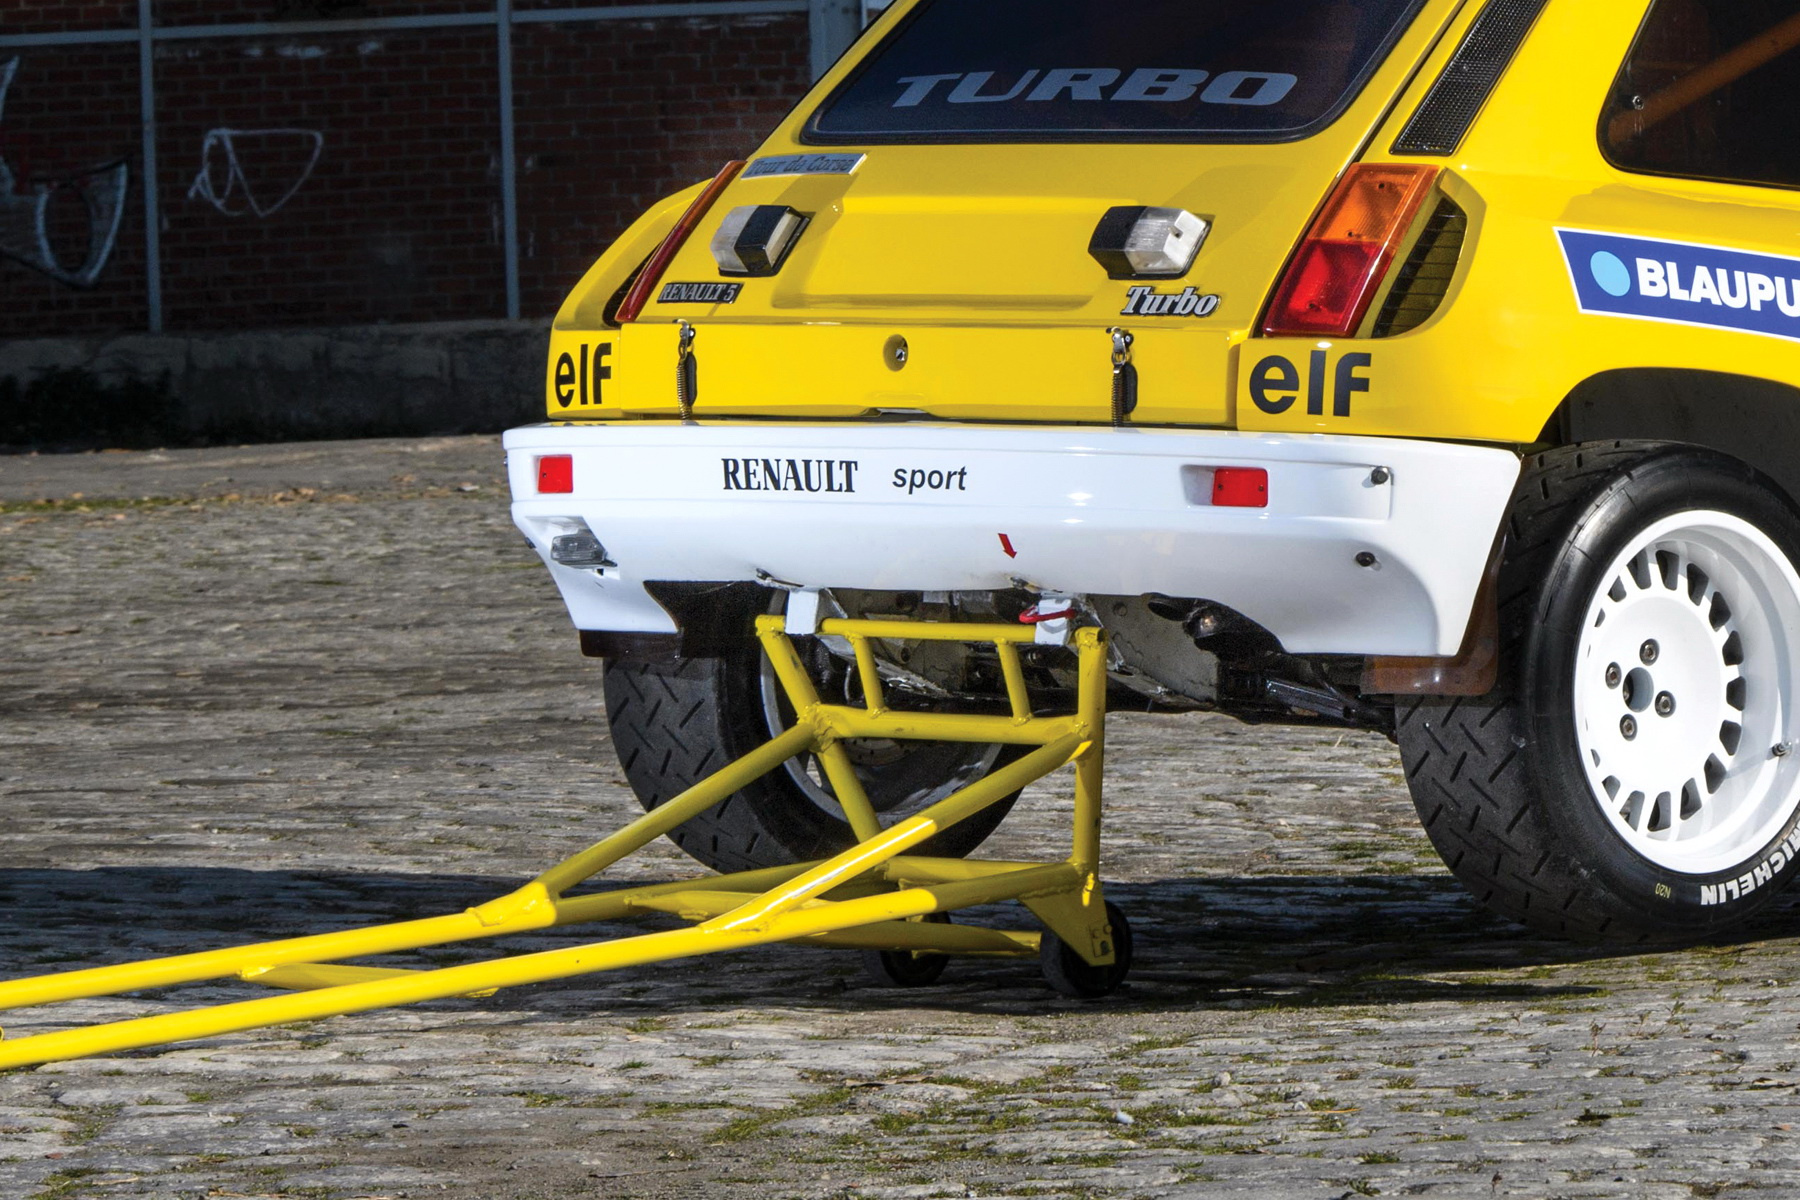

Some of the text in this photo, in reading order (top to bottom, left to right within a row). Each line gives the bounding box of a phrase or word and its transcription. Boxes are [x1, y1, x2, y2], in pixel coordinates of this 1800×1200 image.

[892, 68, 1298, 107] TURBO
[783, 155, 804, 172] de
[806, 156, 855, 171] Corse
[658, 283, 738, 301] RENAULT 5
[1120, 286, 1219, 316] Turbo
[555, 342, 612, 408] elf
[1249, 349, 1372, 417] elf
[721, 458, 967, 495] RENAULT sport
